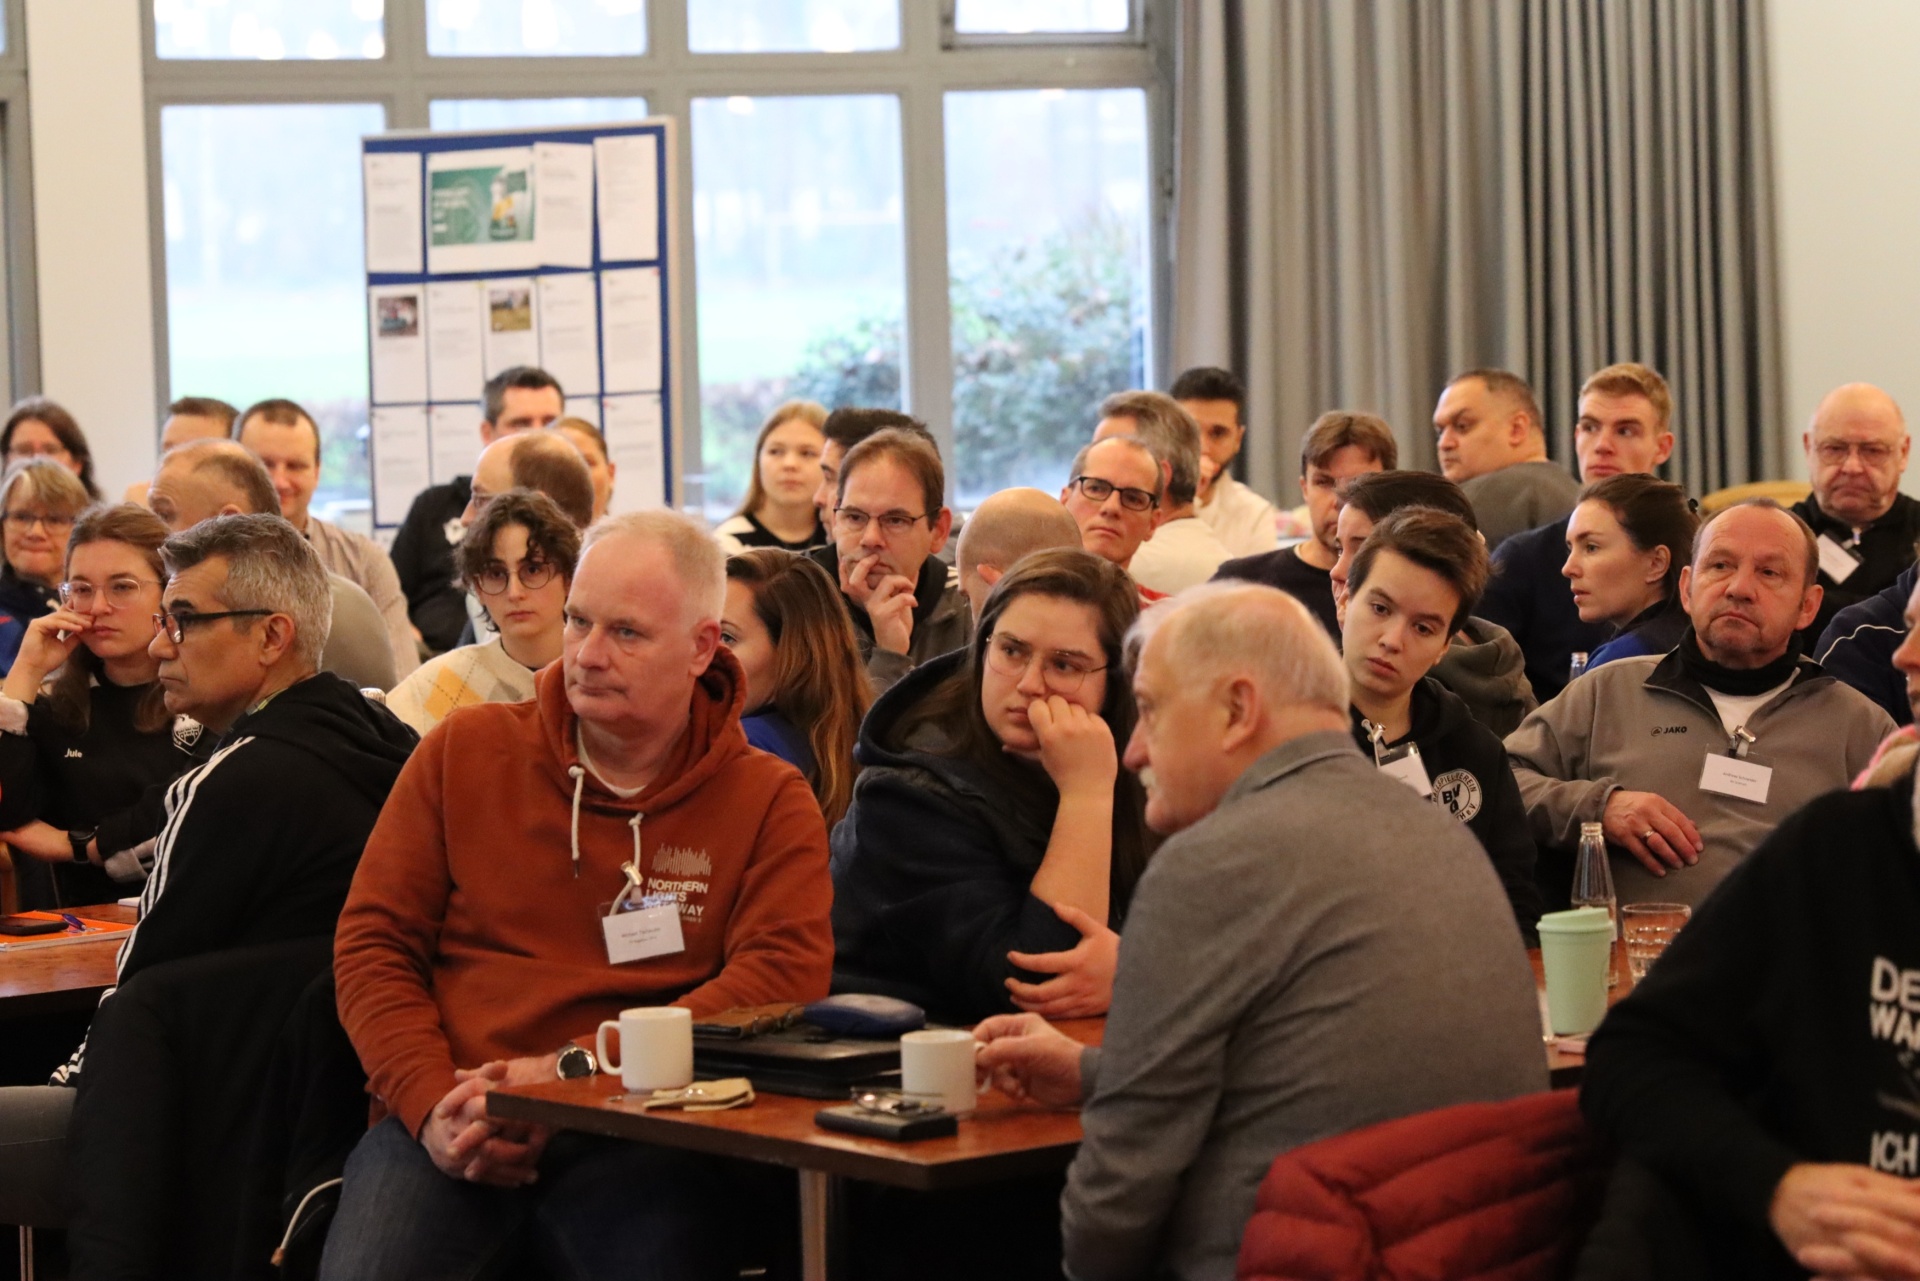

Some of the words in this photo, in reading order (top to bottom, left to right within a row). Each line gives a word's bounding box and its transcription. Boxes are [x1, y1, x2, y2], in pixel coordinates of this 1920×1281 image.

[1663, 726, 1687, 734] JAKO
[64, 748, 83, 758] Jule
[1442, 783, 1461, 805] BV
[647, 877, 709, 894] NORTHERN
[1869, 1001, 1920, 1053] WA
[1869, 1132, 1919, 1175] ICH
